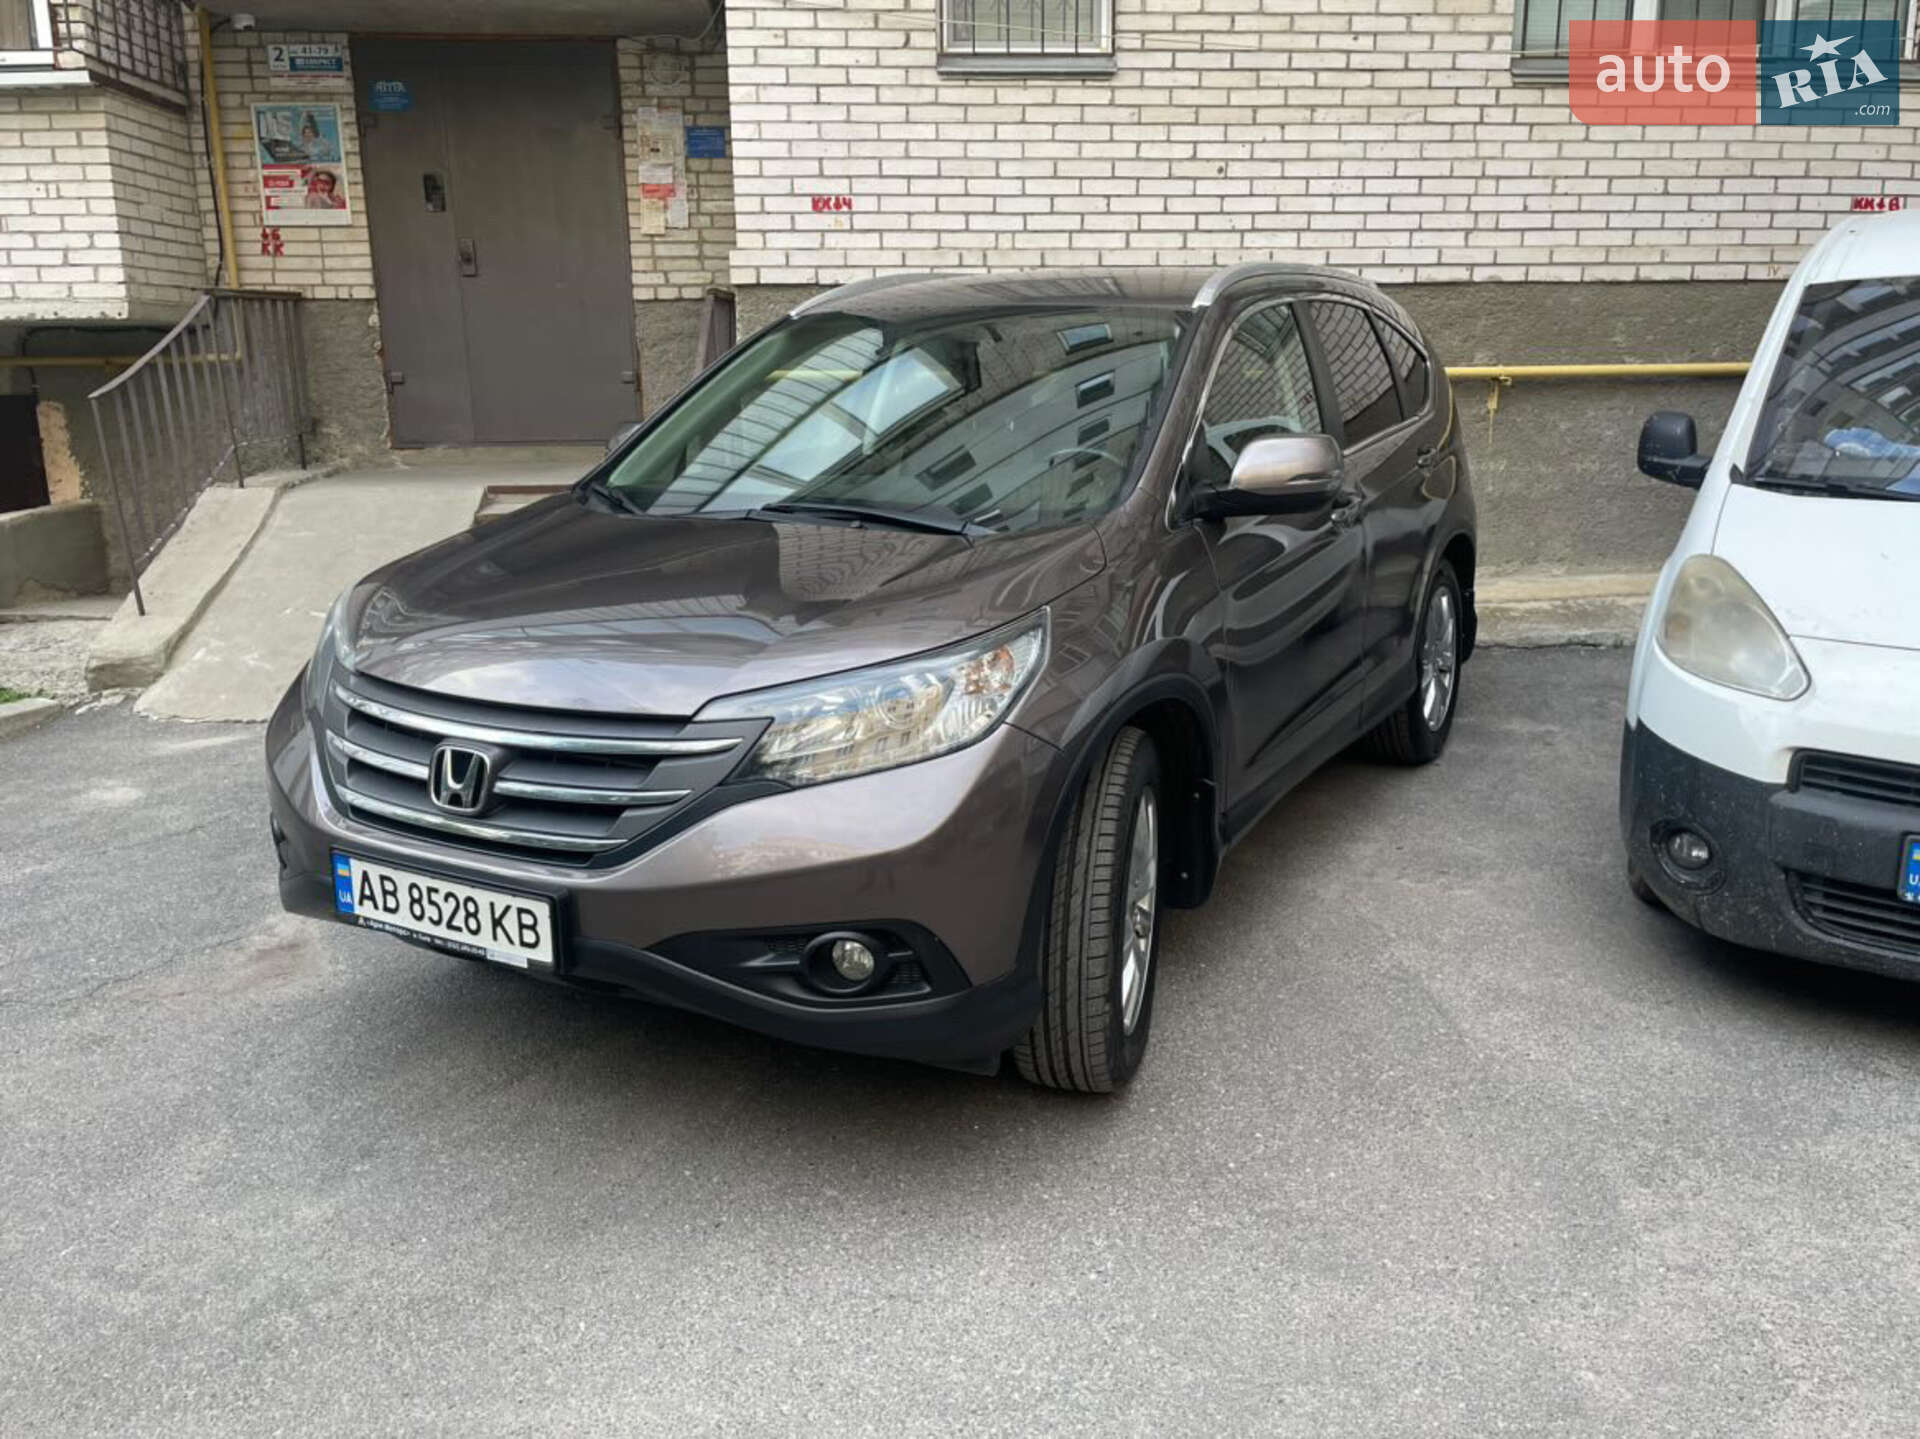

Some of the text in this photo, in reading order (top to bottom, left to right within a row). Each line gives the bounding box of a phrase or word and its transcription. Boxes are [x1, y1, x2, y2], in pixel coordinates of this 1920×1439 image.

[272, 46, 285, 62] 2
[1908, 872, 1920, 886] U
[338, 889, 354, 905] UA
[357, 869, 401, 915] AB
[407, 882, 482, 936] 8528
[489, 901, 541, 950] KB
